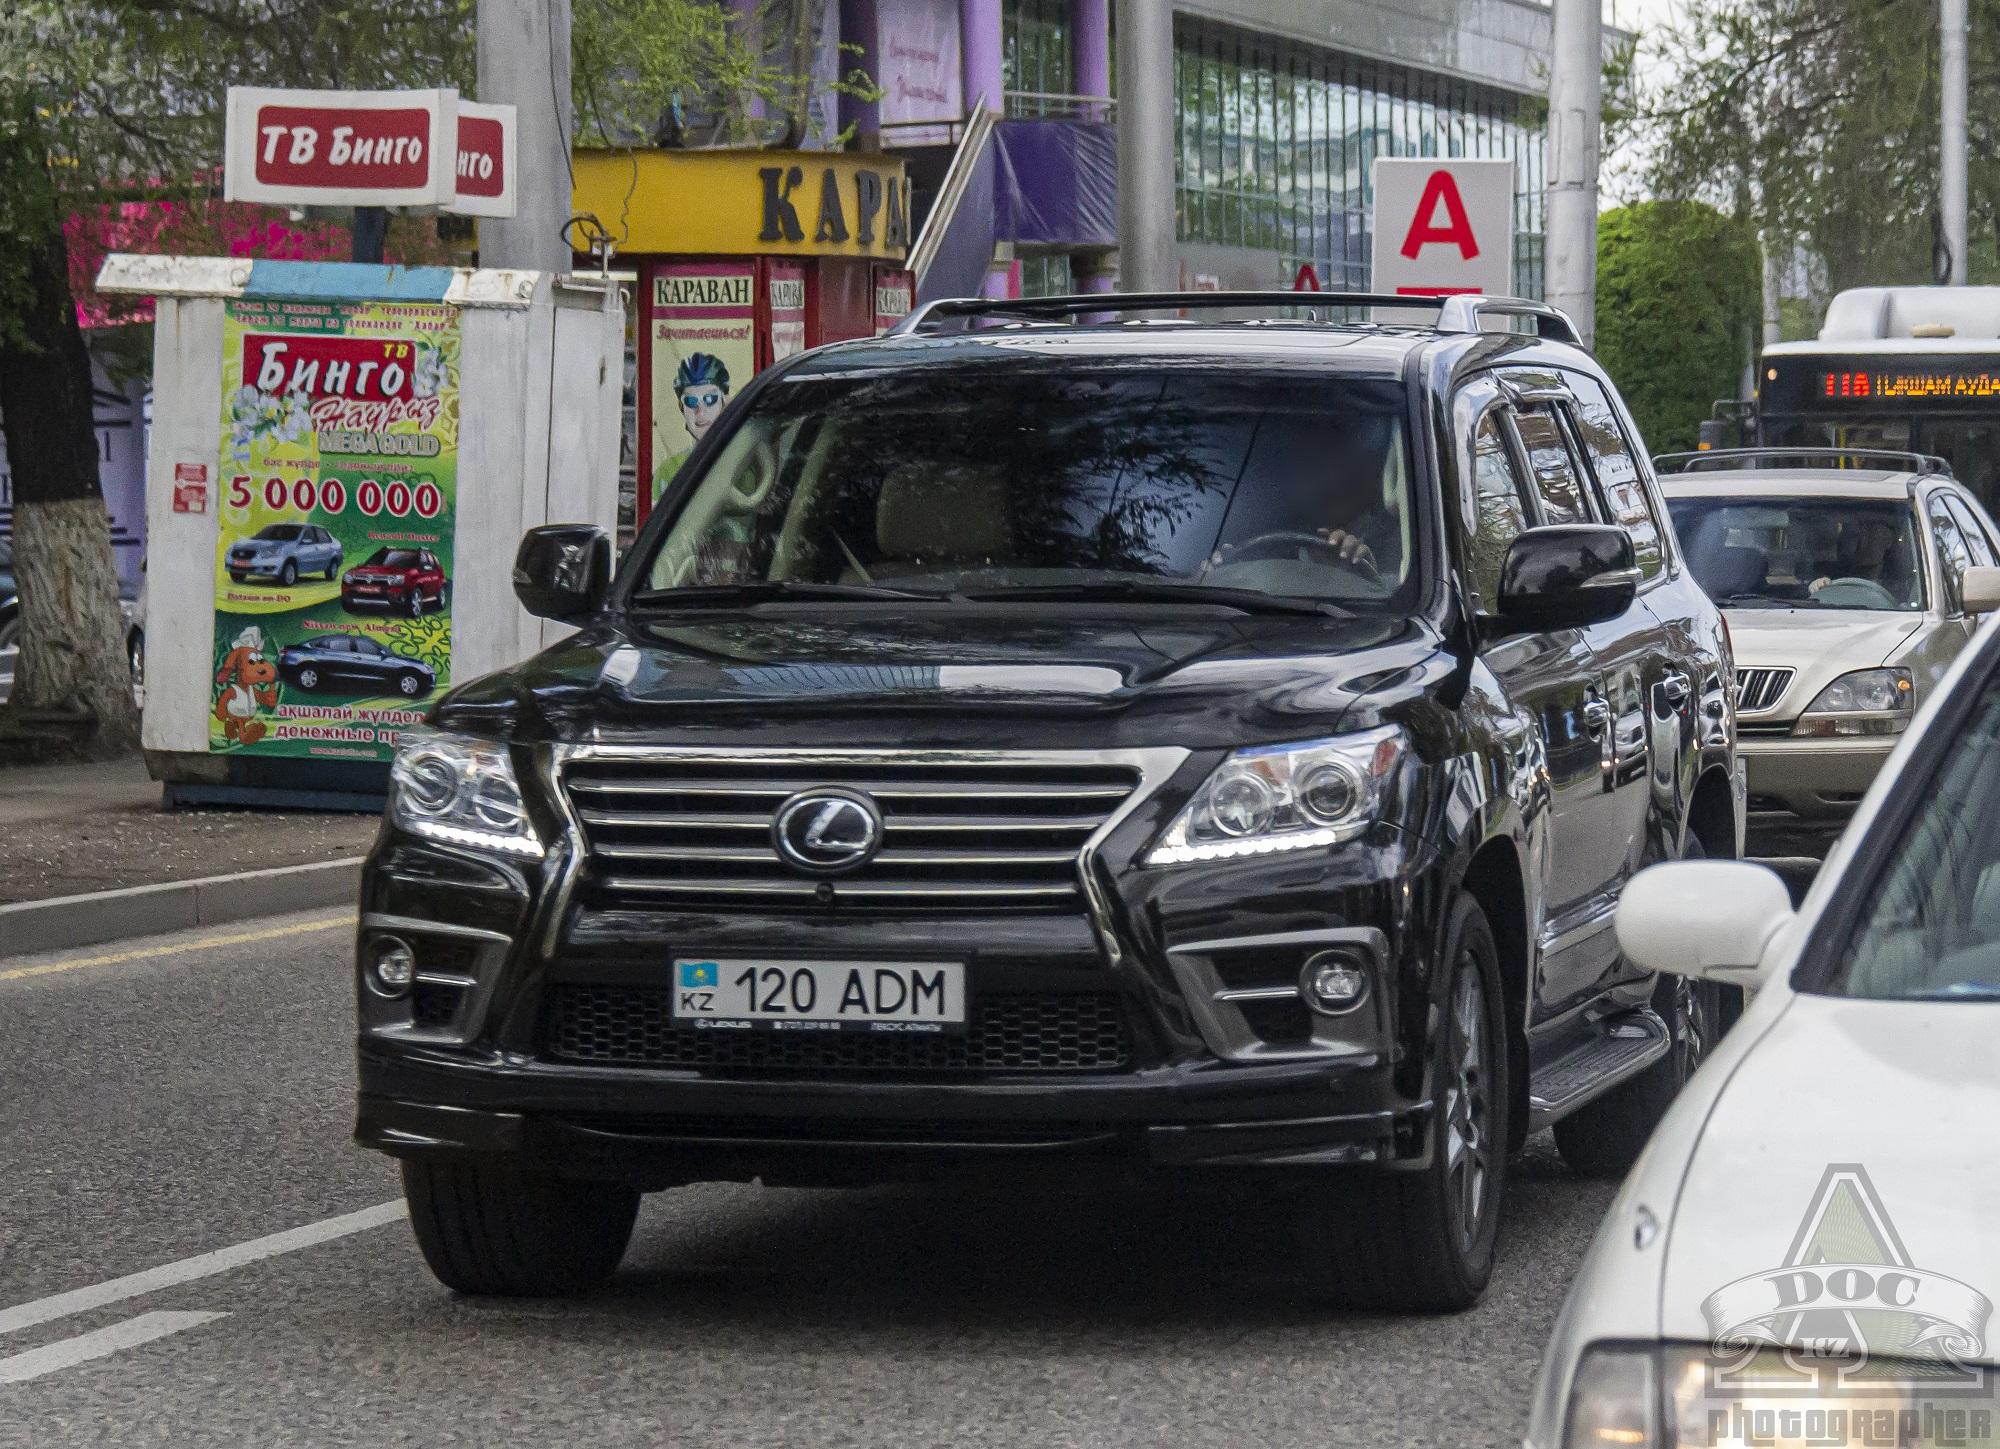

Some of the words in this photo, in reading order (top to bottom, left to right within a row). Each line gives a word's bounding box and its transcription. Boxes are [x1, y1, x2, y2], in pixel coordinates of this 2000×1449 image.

[262, 126, 318, 164] ТВ
[329, 126, 422, 165] Бинго
[656, 279, 749, 304] КАРАВАН
[383, 344, 409, 359] ТВ
[256, 342, 405, 396] Бинго
[229, 475, 251, 508] 5
[264, 477, 346, 515] 000
[357, 479, 441, 517] 000
[278, 704, 352, 720] ақшалай
[275, 726, 374, 742] денежные
[681, 992, 714, 1011] KZ
[735, 967, 816, 1013] 120
[839, 969, 945, 1015] ADM
